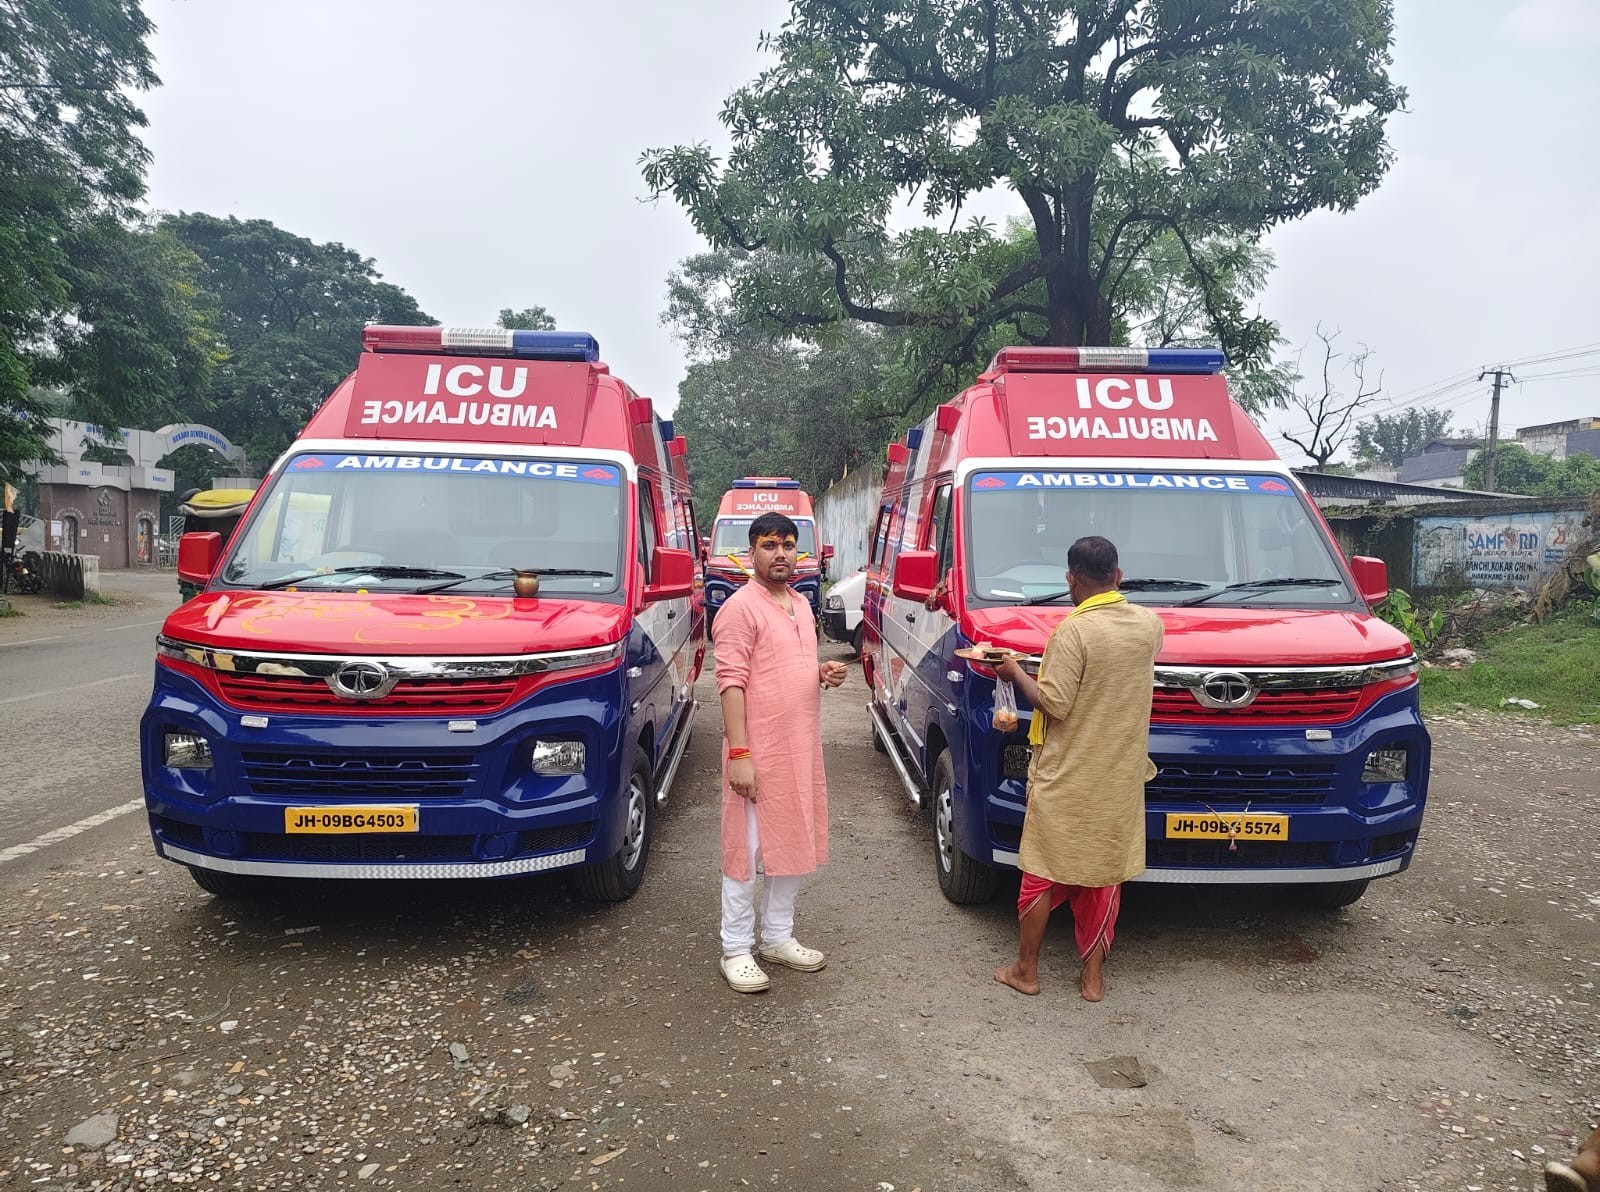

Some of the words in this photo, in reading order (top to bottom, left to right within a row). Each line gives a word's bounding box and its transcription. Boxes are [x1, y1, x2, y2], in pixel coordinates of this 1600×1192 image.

[424, 364, 528, 398] ICU
[1076, 378, 1174, 410] ICU
[335, 455, 578, 478] AMBULANCE
[1016, 472, 1250, 491] AMBULANCE
[753, 493, 778, 502] ICU
[294, 814, 405, 828] JH-09BG4503
